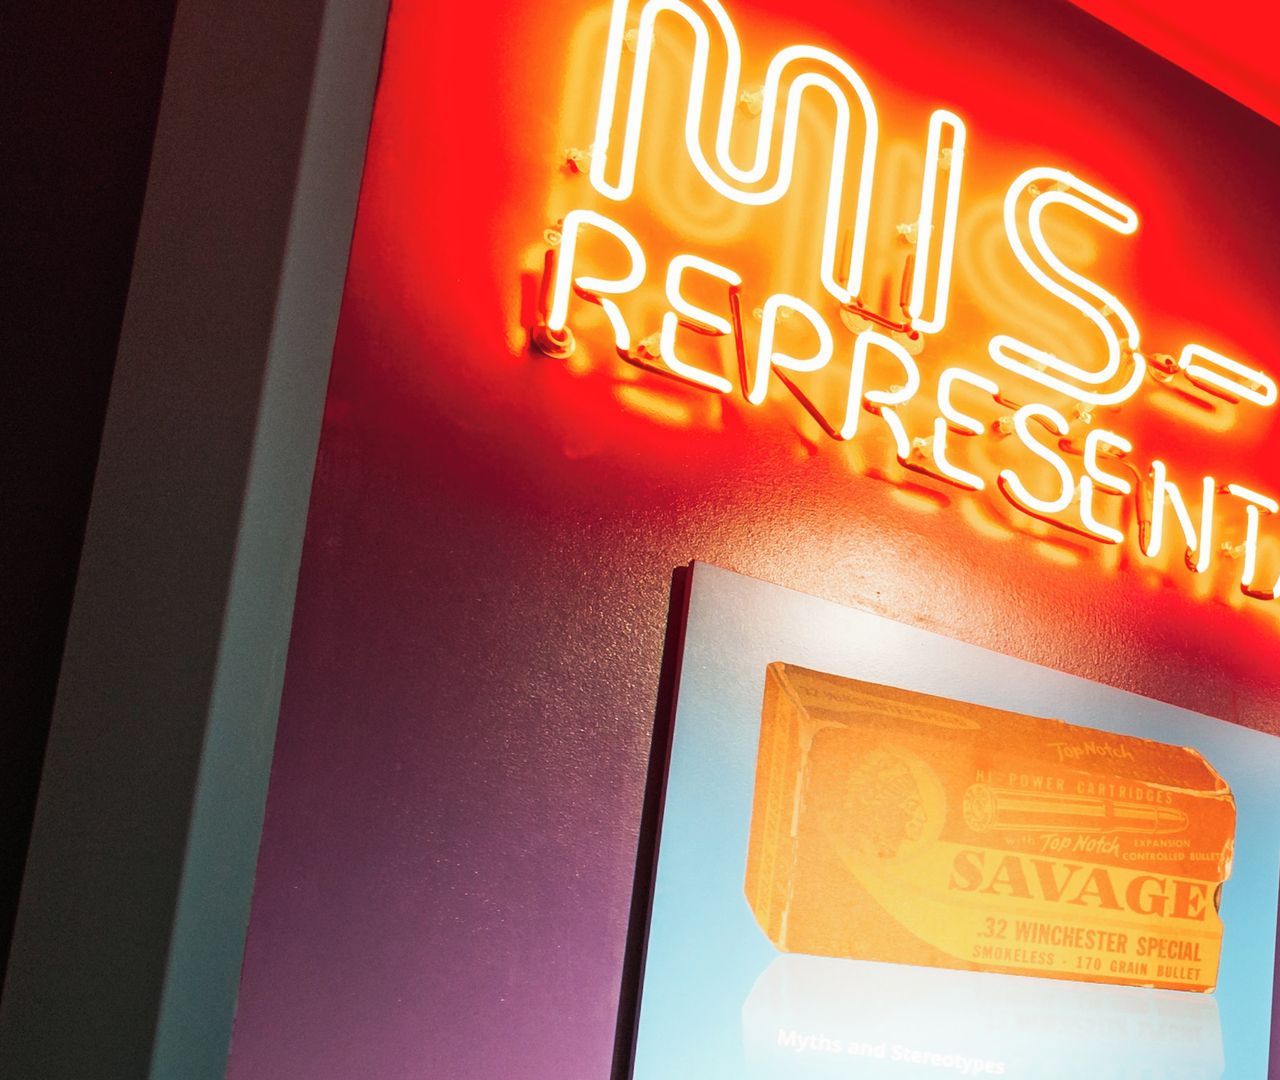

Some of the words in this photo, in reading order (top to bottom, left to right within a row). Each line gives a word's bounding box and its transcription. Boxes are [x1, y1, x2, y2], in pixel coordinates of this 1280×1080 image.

[591, 0, 1278, 405] MIS-
[1008, 772, 1065, 795] POWER
[1076, 780, 1174, 805] CARTRIDGES
[1073, 835, 1120, 857] Notch
[1134, 839, 1191, 848] EXPANSION
[1122, 852, 1185, 861] CONTROLLED
[947, 849, 1208, 922] SAVAGE
[976, 916, 1008, 940] .32
[1015, 922, 1128, 954] WINCHESTER
[1136, 935, 1202, 962] SPECIAL
[972, 944, 1055, 965] SMOKELESS
[1075, 955, 1102, 971] 170
[1109, 958, 1148, 976] GRAIN
[1156, 963, 1201, 981] BULLET
[774, 1029, 844, 1051] Myths
[846, 1041, 888, 1057] and
[889, 1044, 1006, 1073] Stereotypes
